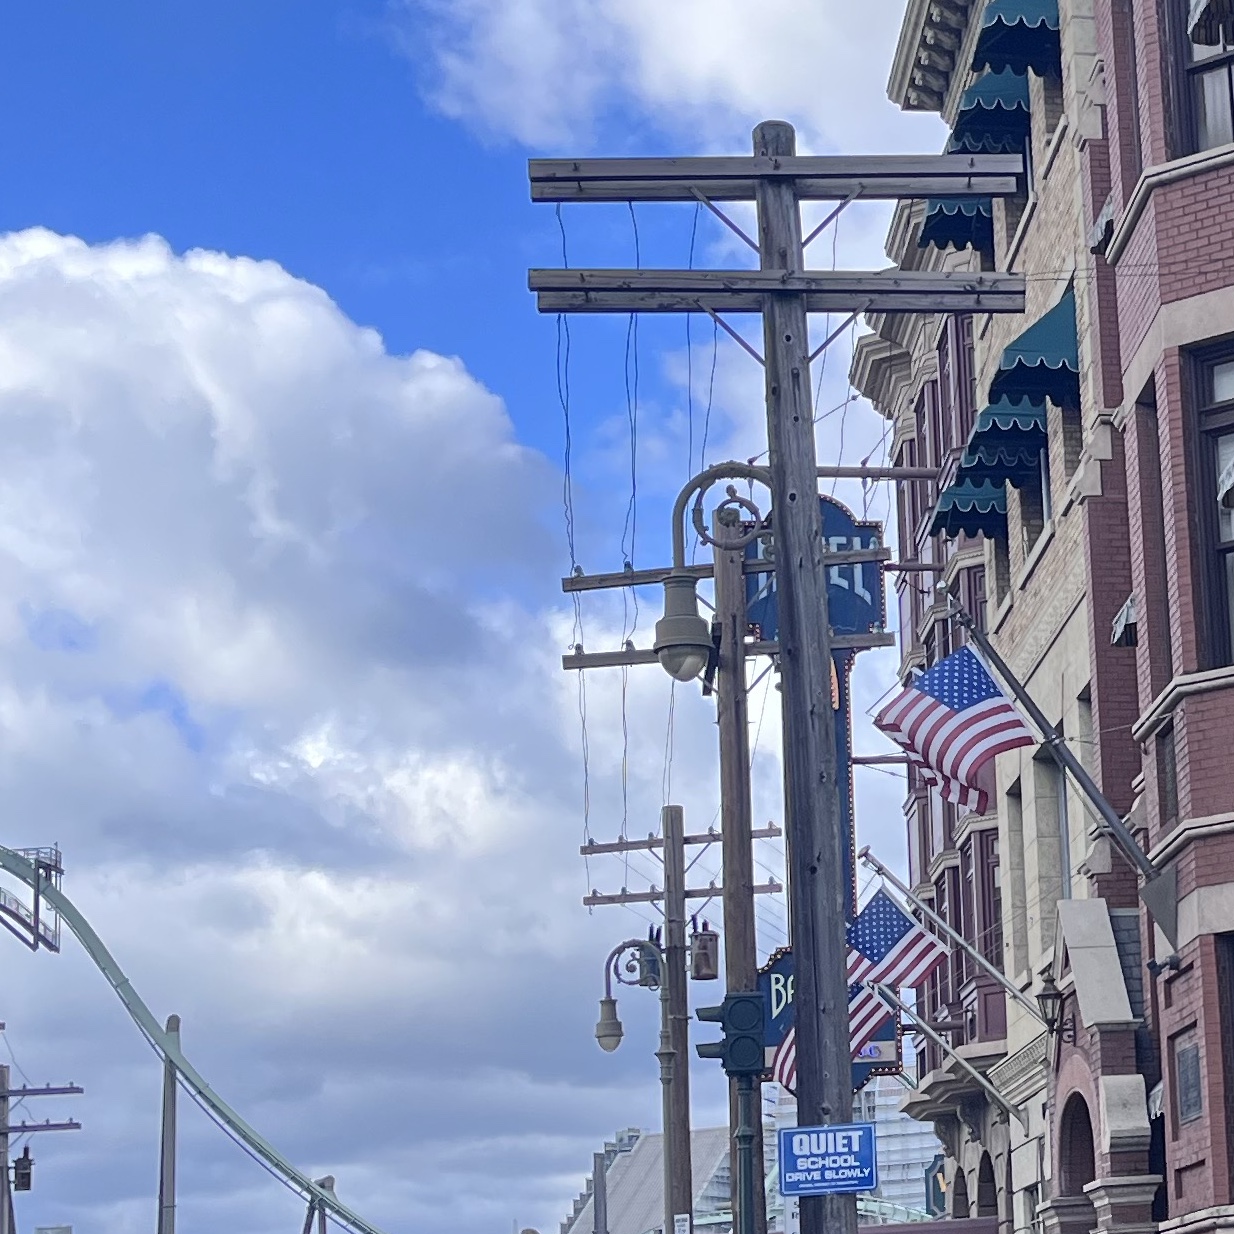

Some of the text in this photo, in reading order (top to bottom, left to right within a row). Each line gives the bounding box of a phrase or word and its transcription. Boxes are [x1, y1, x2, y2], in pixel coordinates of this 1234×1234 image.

[792, 1130, 864, 1156] QUIET
[796, 1154, 861, 1170] SCHOOL
[785, 1167, 871, 1182] DRIVE SLOWLY
